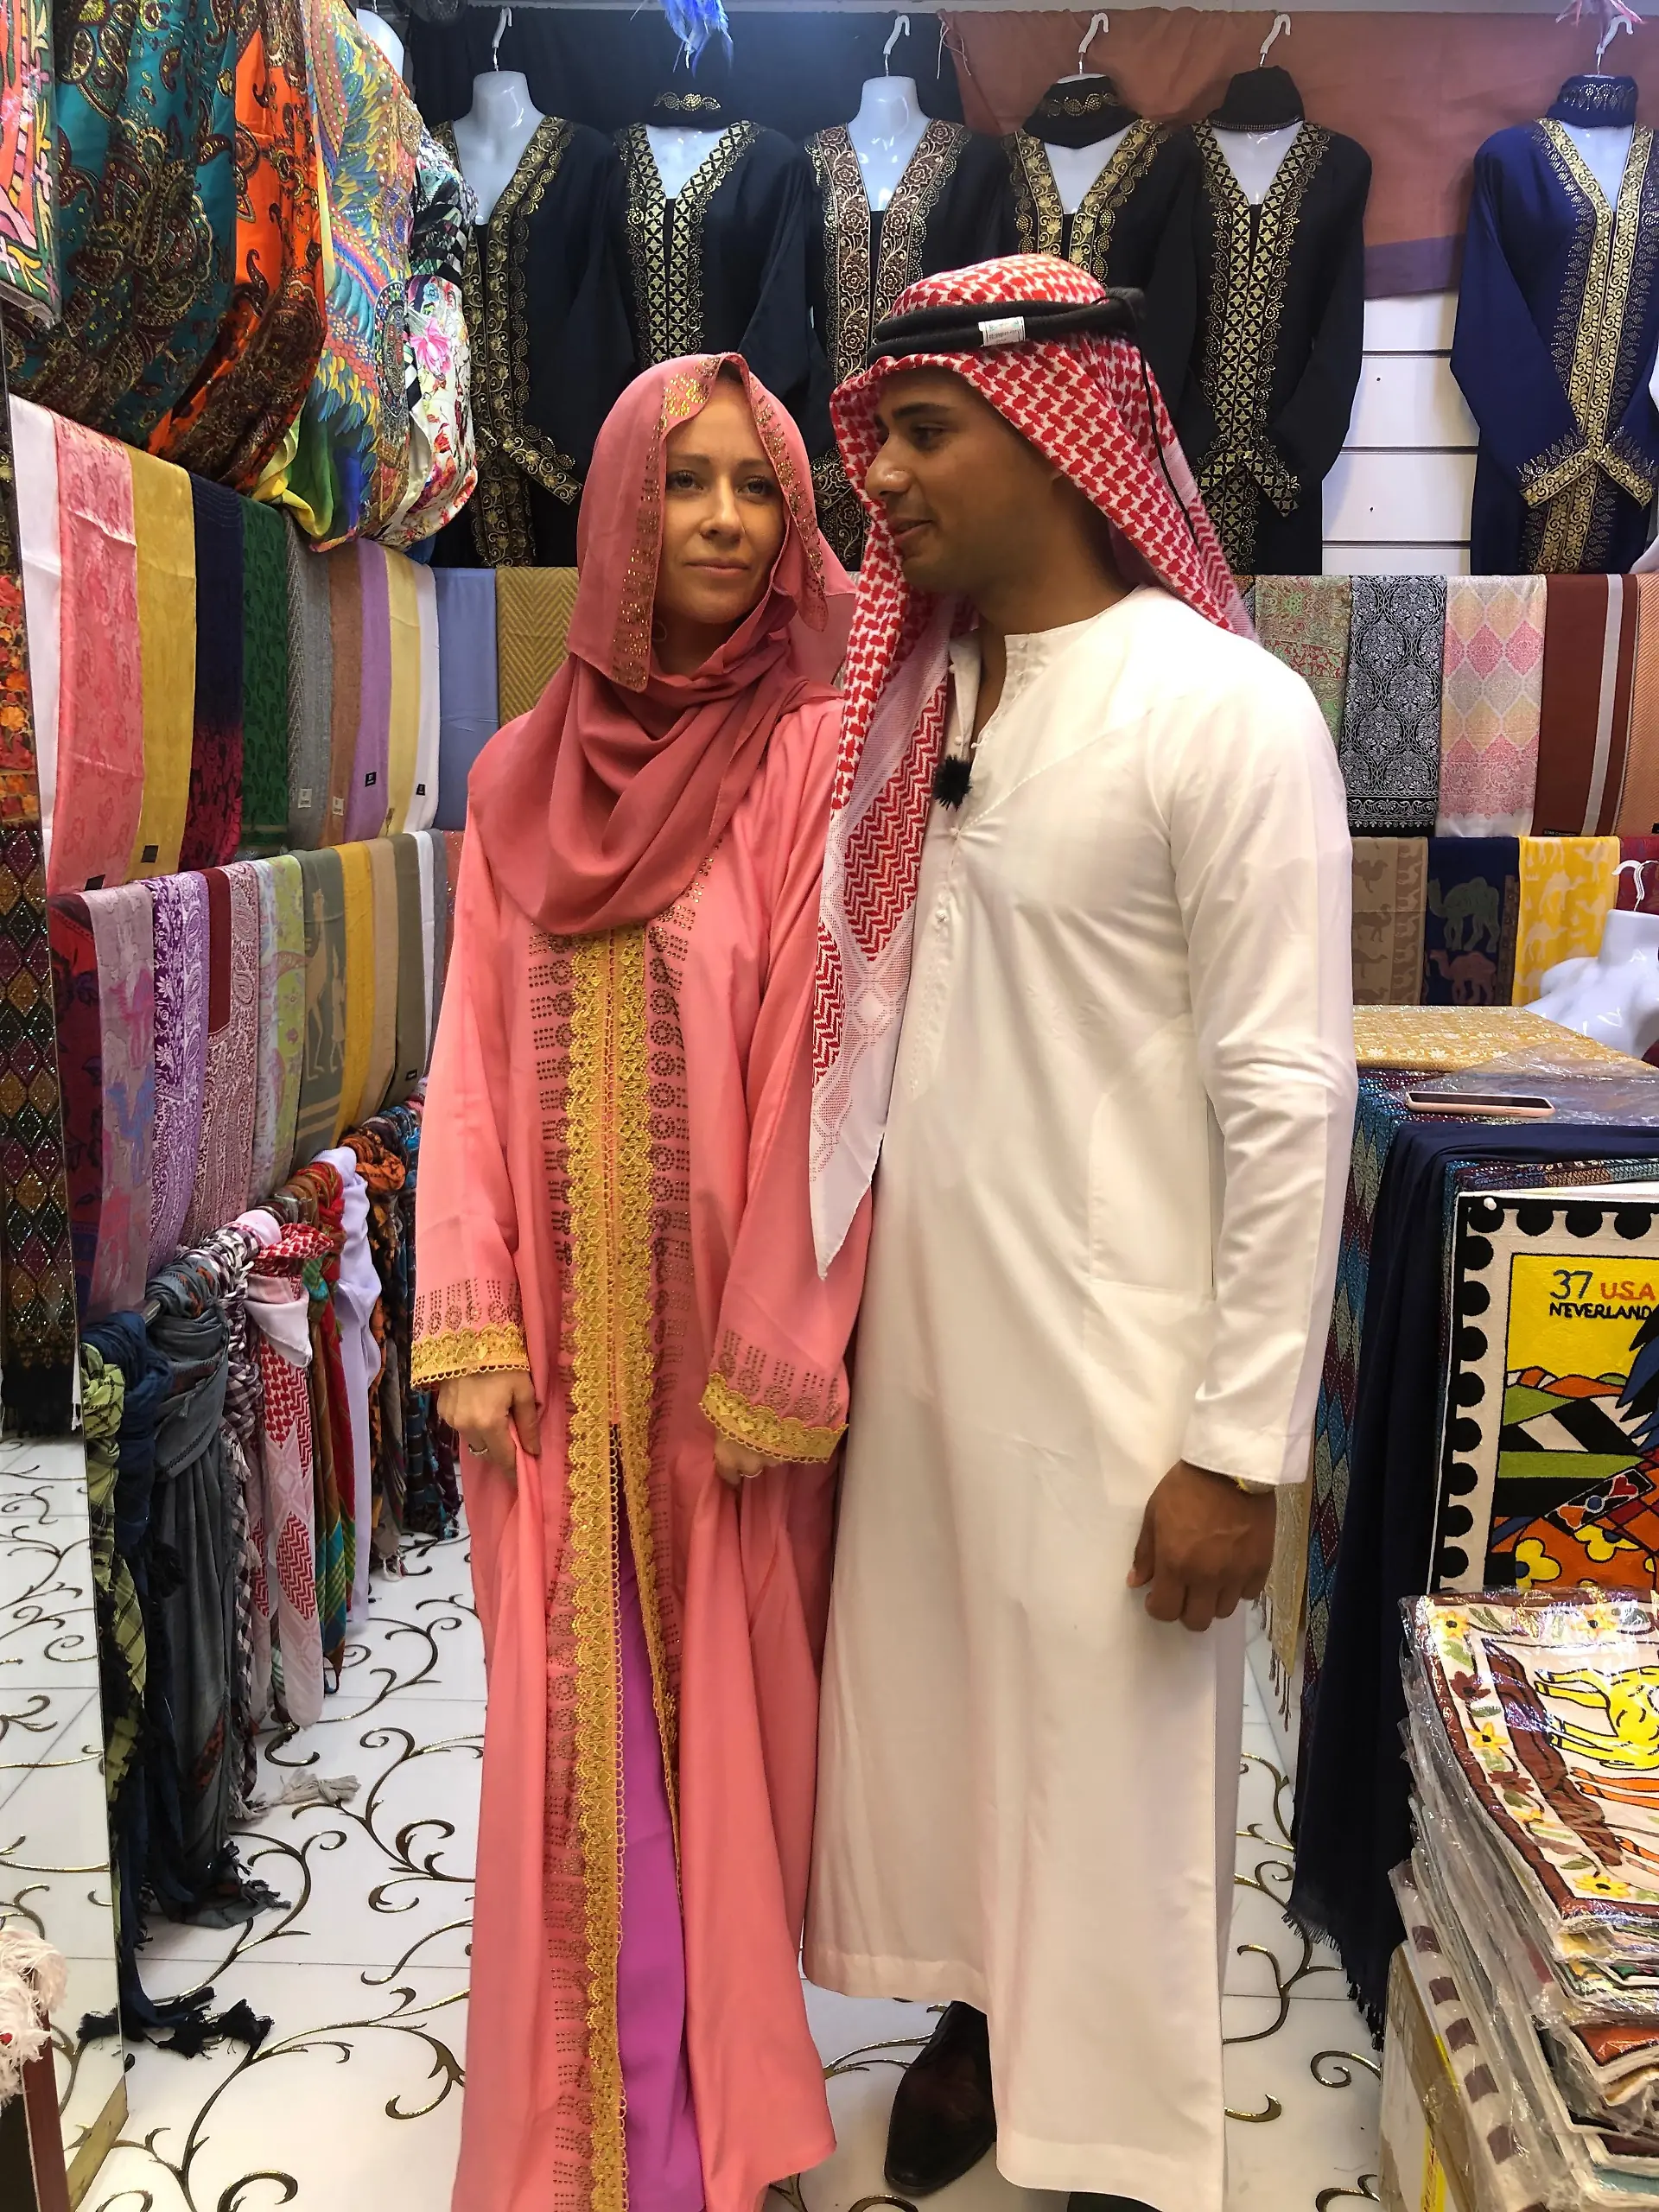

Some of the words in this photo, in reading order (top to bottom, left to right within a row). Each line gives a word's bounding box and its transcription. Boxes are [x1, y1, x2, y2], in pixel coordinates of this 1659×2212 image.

[1549, 1269, 1593, 1300] 37
[1600, 1281, 1656, 1301] USA
[1549, 1301, 1654, 1320] NEVERLAND
